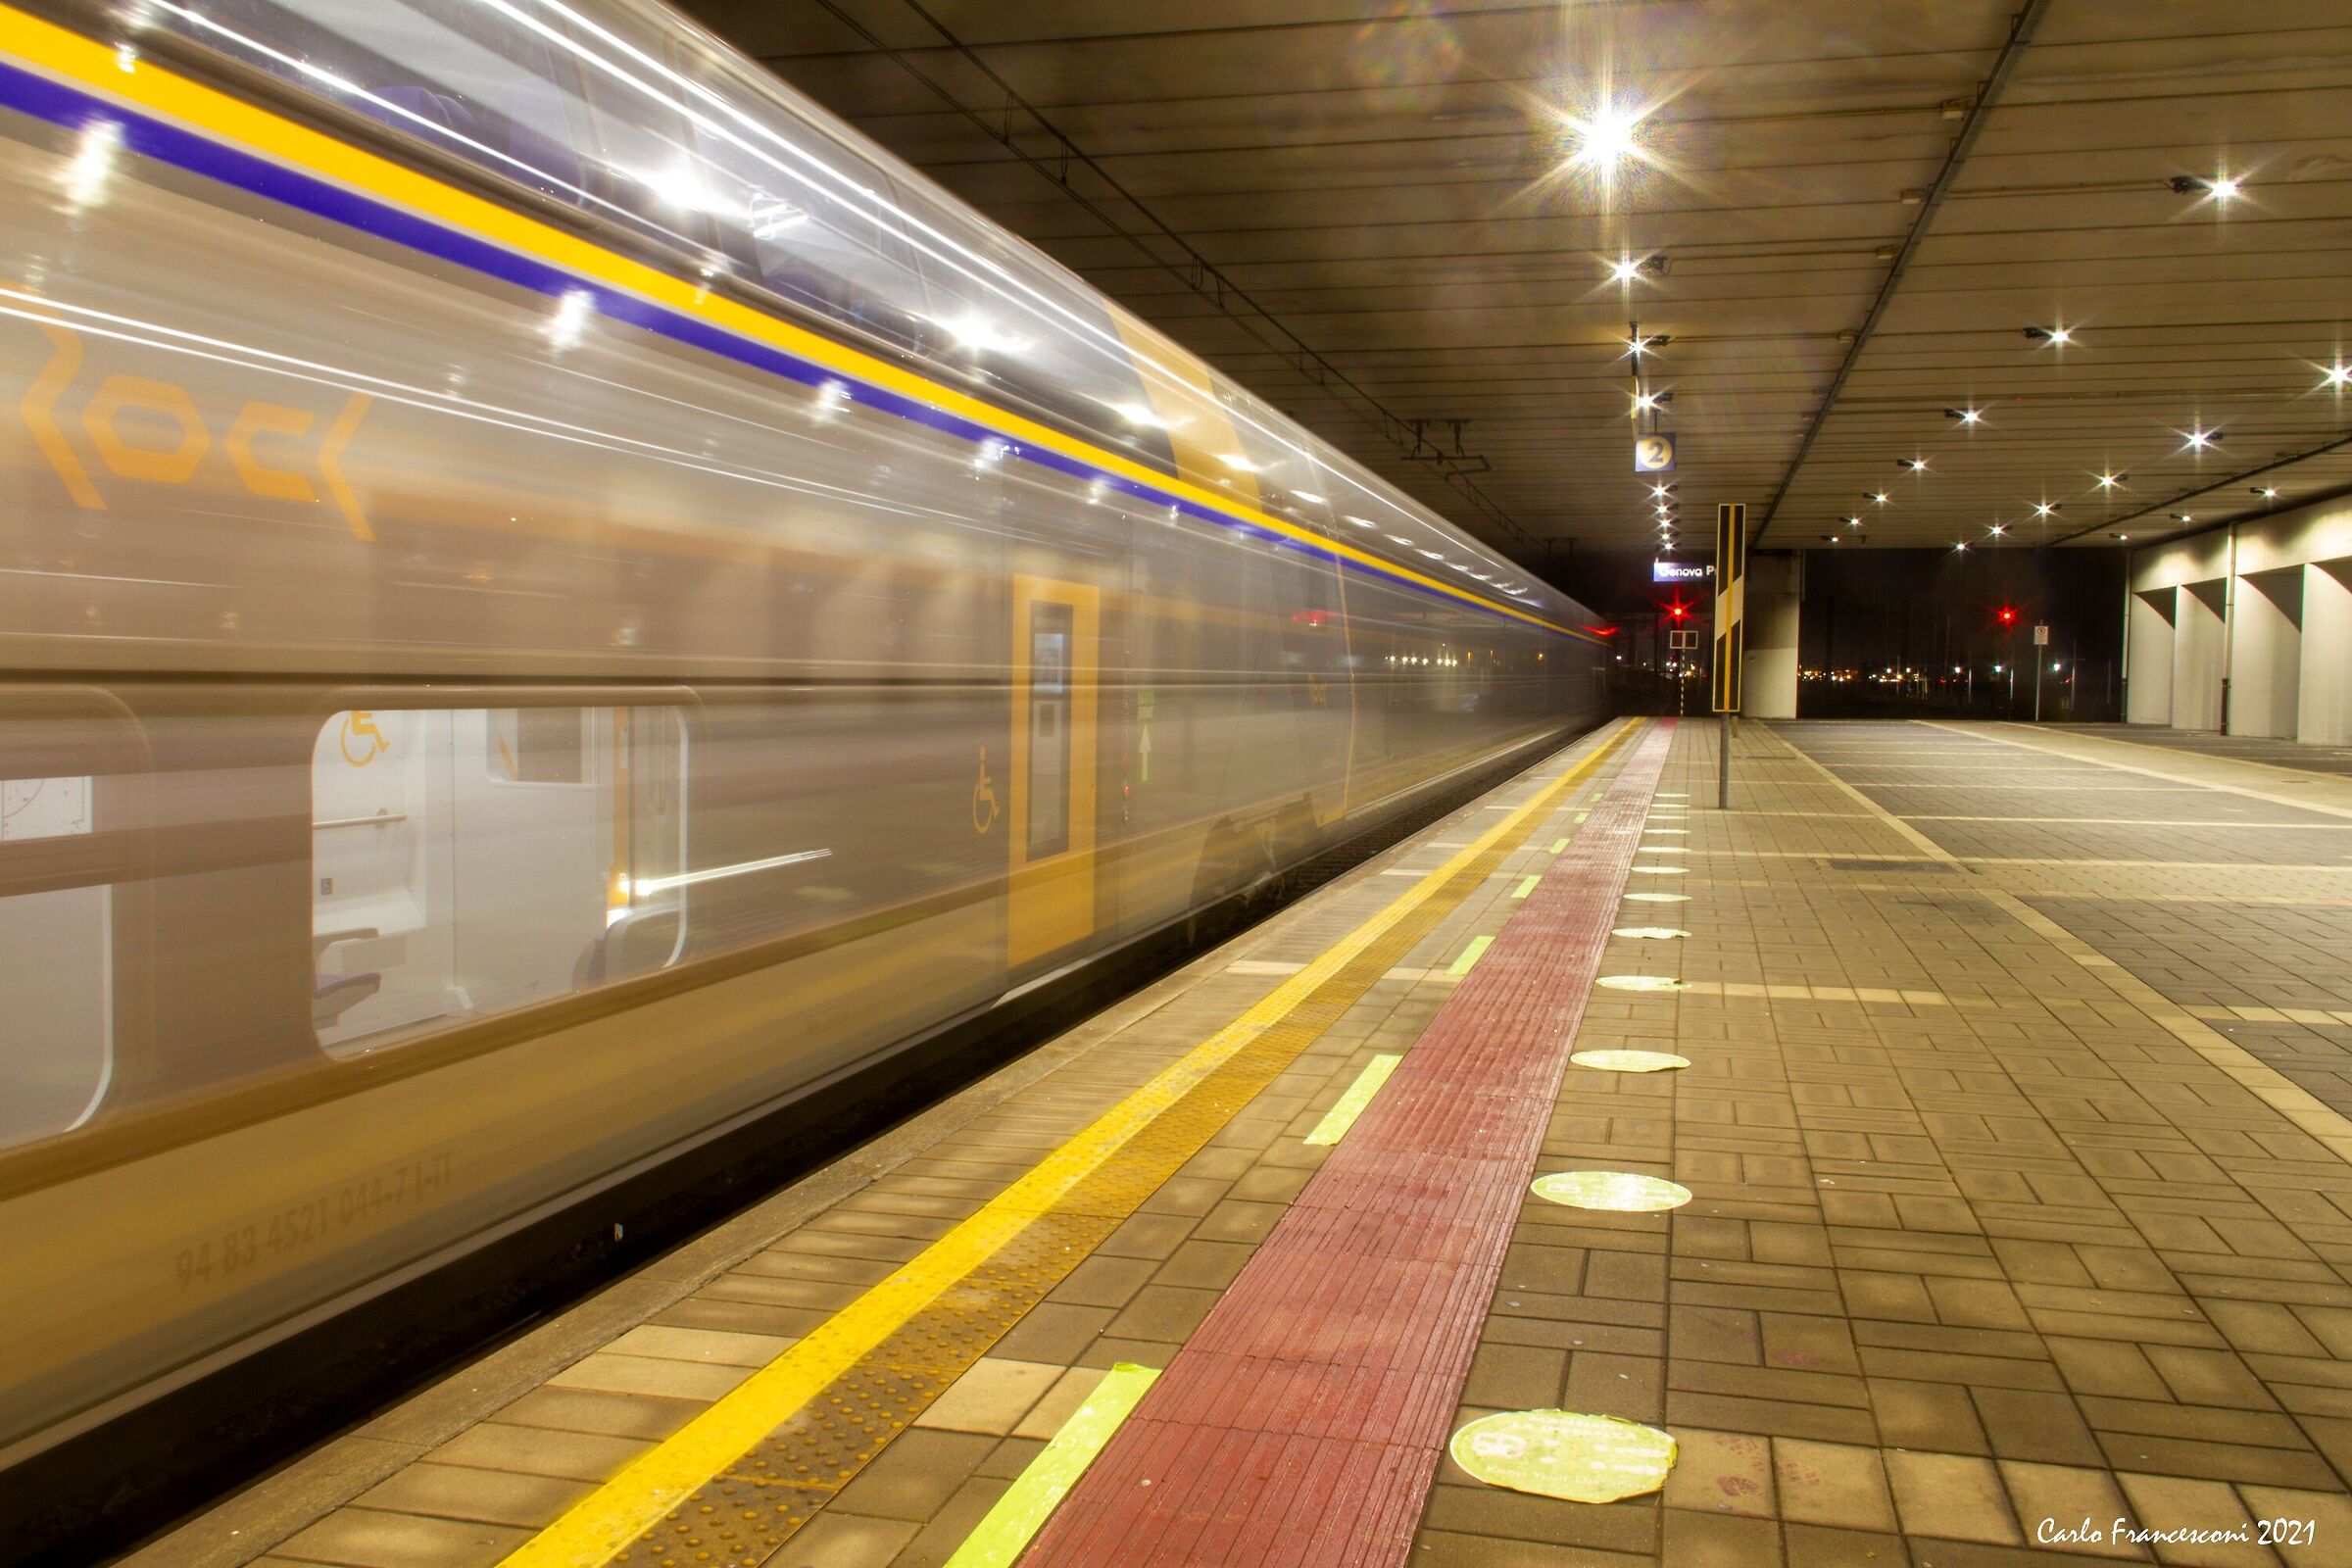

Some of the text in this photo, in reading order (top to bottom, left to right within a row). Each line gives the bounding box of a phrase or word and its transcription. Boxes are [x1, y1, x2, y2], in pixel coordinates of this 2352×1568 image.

[1647, 442, 1663, 463] 2
[1659, 565, 1703, 577] Genova
[175, 1241, 212, 1294] 94
[223, 1225, 258, 1274] 83
[267, 1197, 327, 1254] 4521
